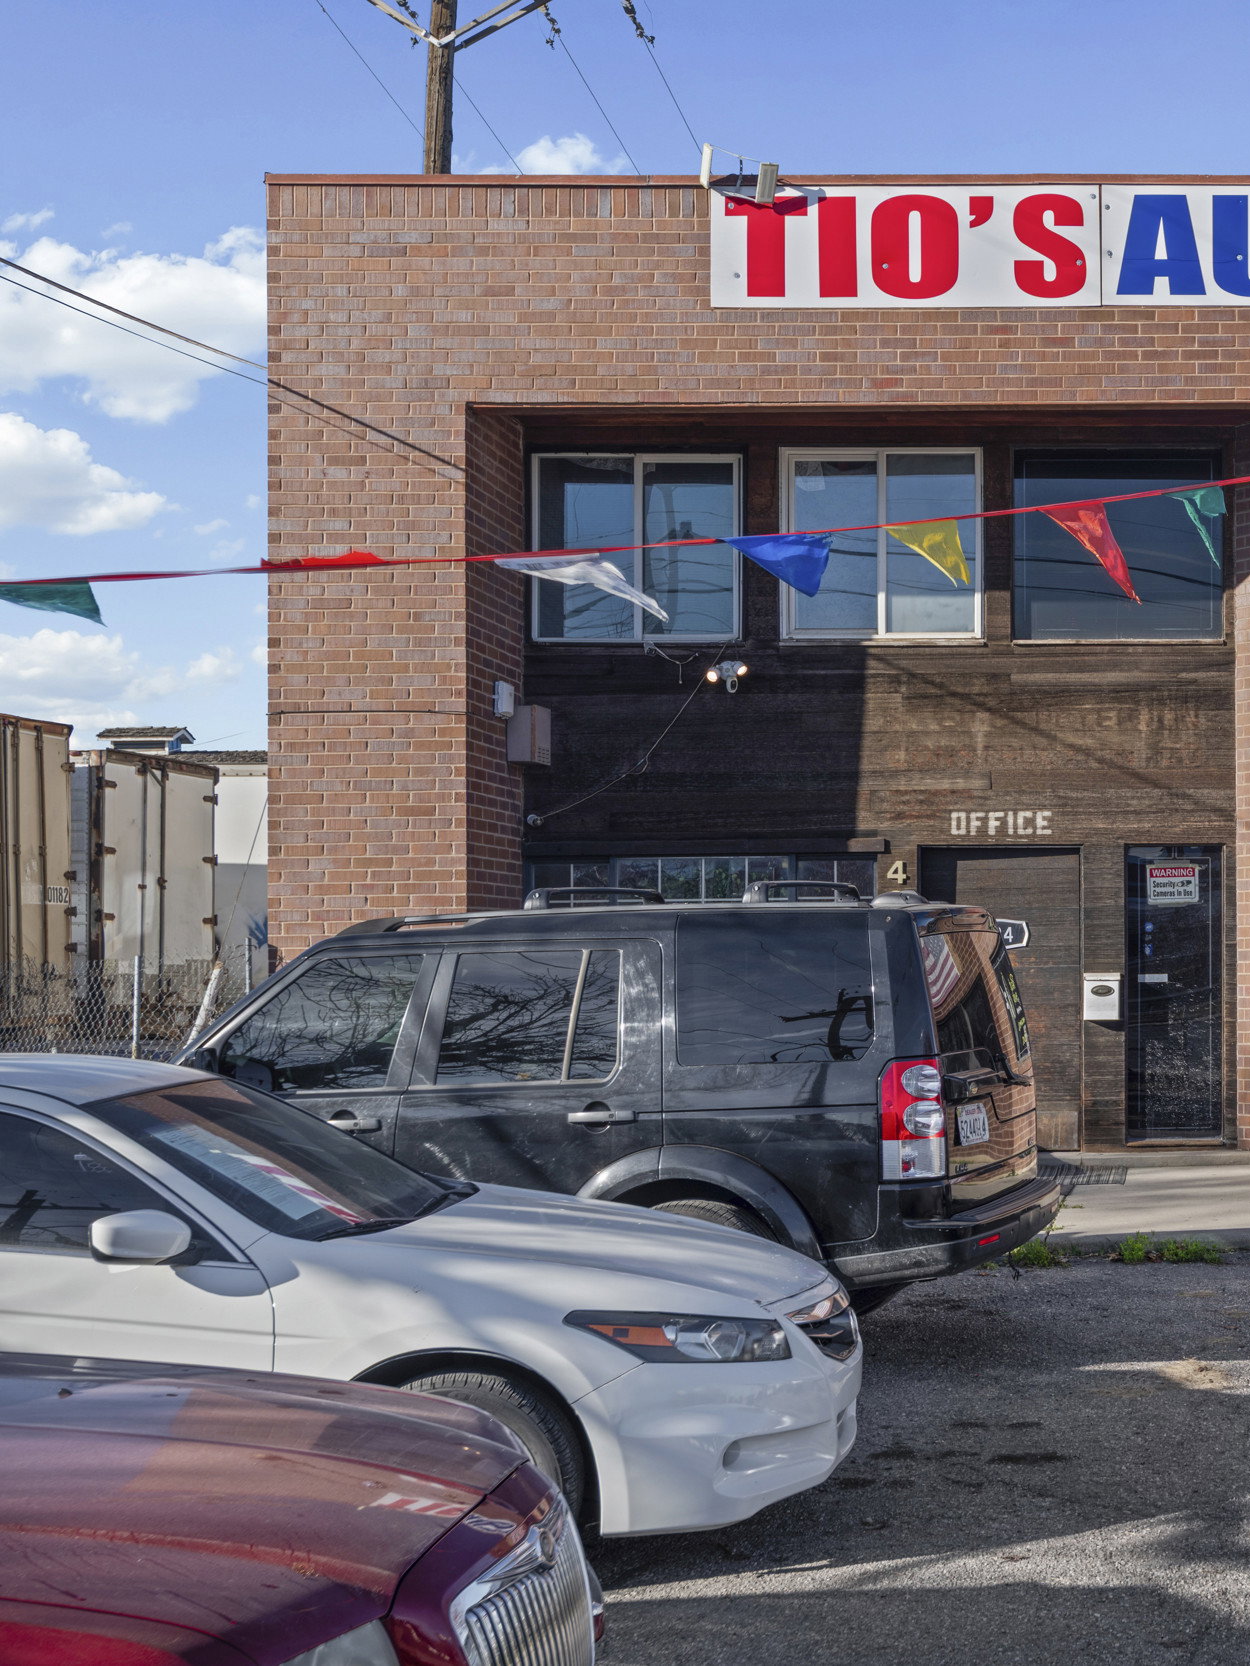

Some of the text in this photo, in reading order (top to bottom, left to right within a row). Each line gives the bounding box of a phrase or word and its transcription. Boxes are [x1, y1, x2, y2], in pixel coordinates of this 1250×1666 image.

[724, 193, 1087, 300] TIO'S
[951, 811, 1052, 836] OFFICE
[886, 860, 907, 884] 4
[1152, 868, 1193, 877] WARNING
[1152, 880, 1176, 890] Security
[1152, 888, 1193, 898] Cameras In Use
[999, 926, 1014, 943] 4
